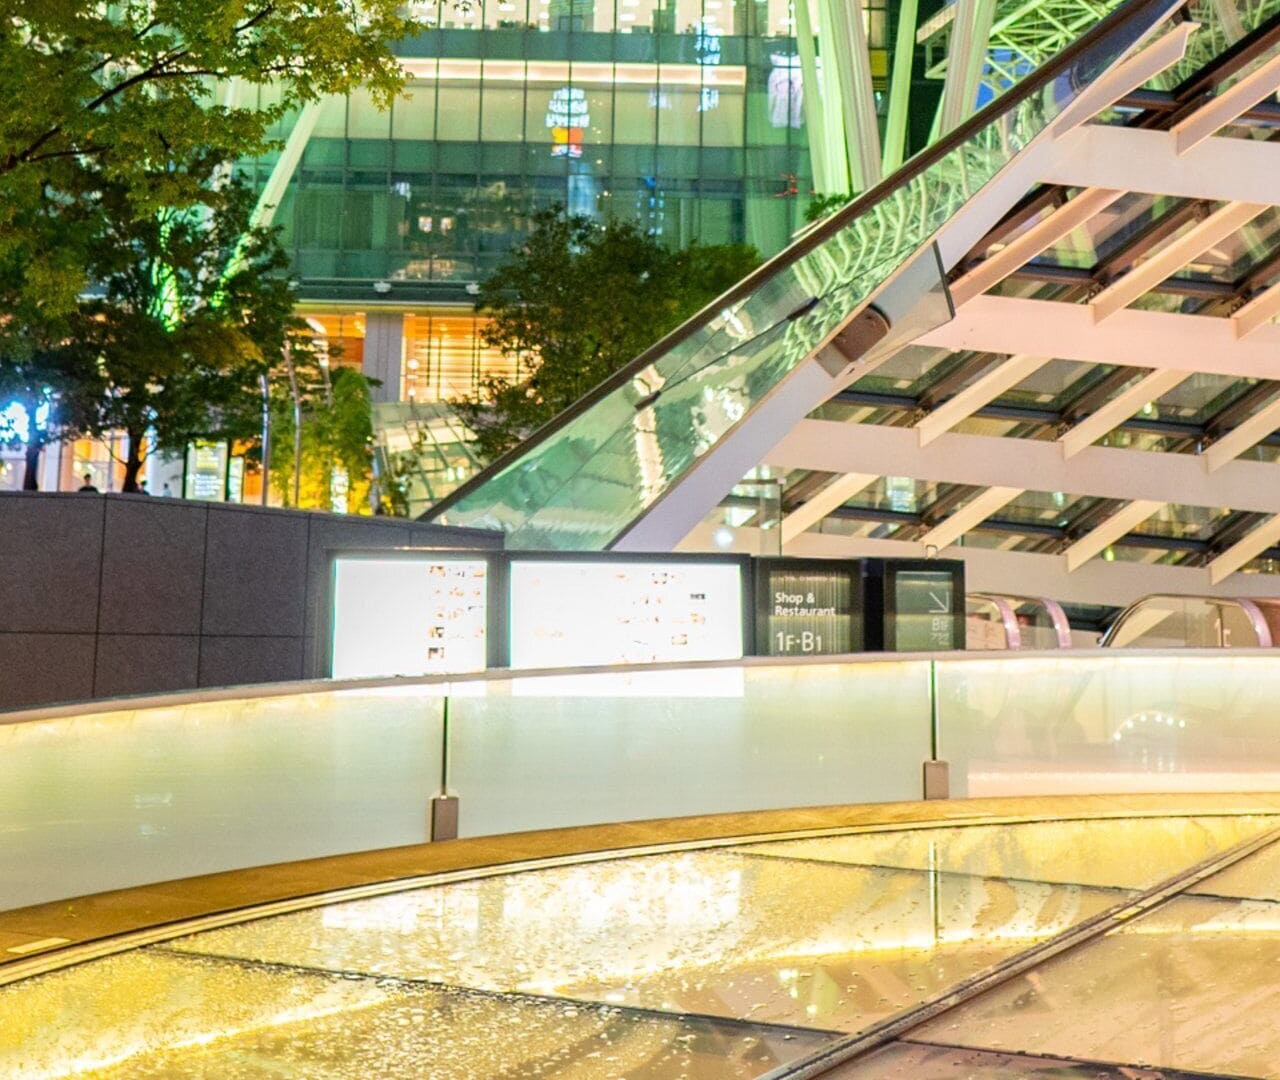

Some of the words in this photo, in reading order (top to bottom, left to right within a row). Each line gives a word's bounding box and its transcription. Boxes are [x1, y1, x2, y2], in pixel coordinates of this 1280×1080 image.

[775, 592, 803, 605] Shop
[806, 592, 815, 604] &
[775, 606, 836, 616] Restaurant
